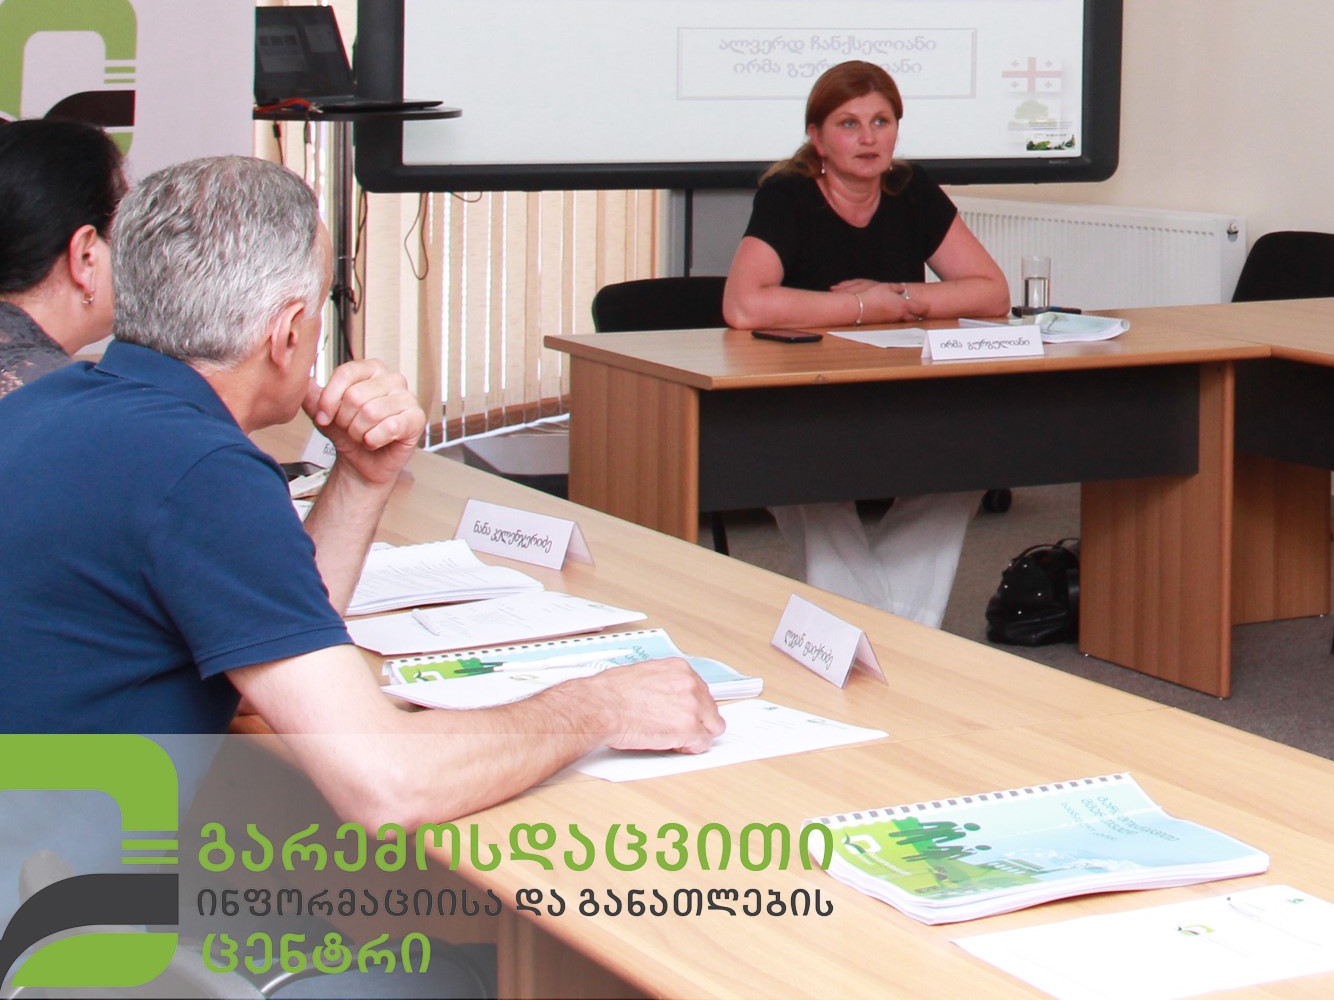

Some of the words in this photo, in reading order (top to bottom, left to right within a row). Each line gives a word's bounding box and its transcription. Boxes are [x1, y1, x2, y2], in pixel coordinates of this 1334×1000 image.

[719, 36, 805, 55] ალვერდ
[810, 35, 937, 55] ჩანქსელიანი
[733, 59, 781, 74] ირმა
[940, 340, 963, 349] ირმა
[967, 338, 1030, 351] გურგულიანი
[473, 520, 492, 535] ნანა
